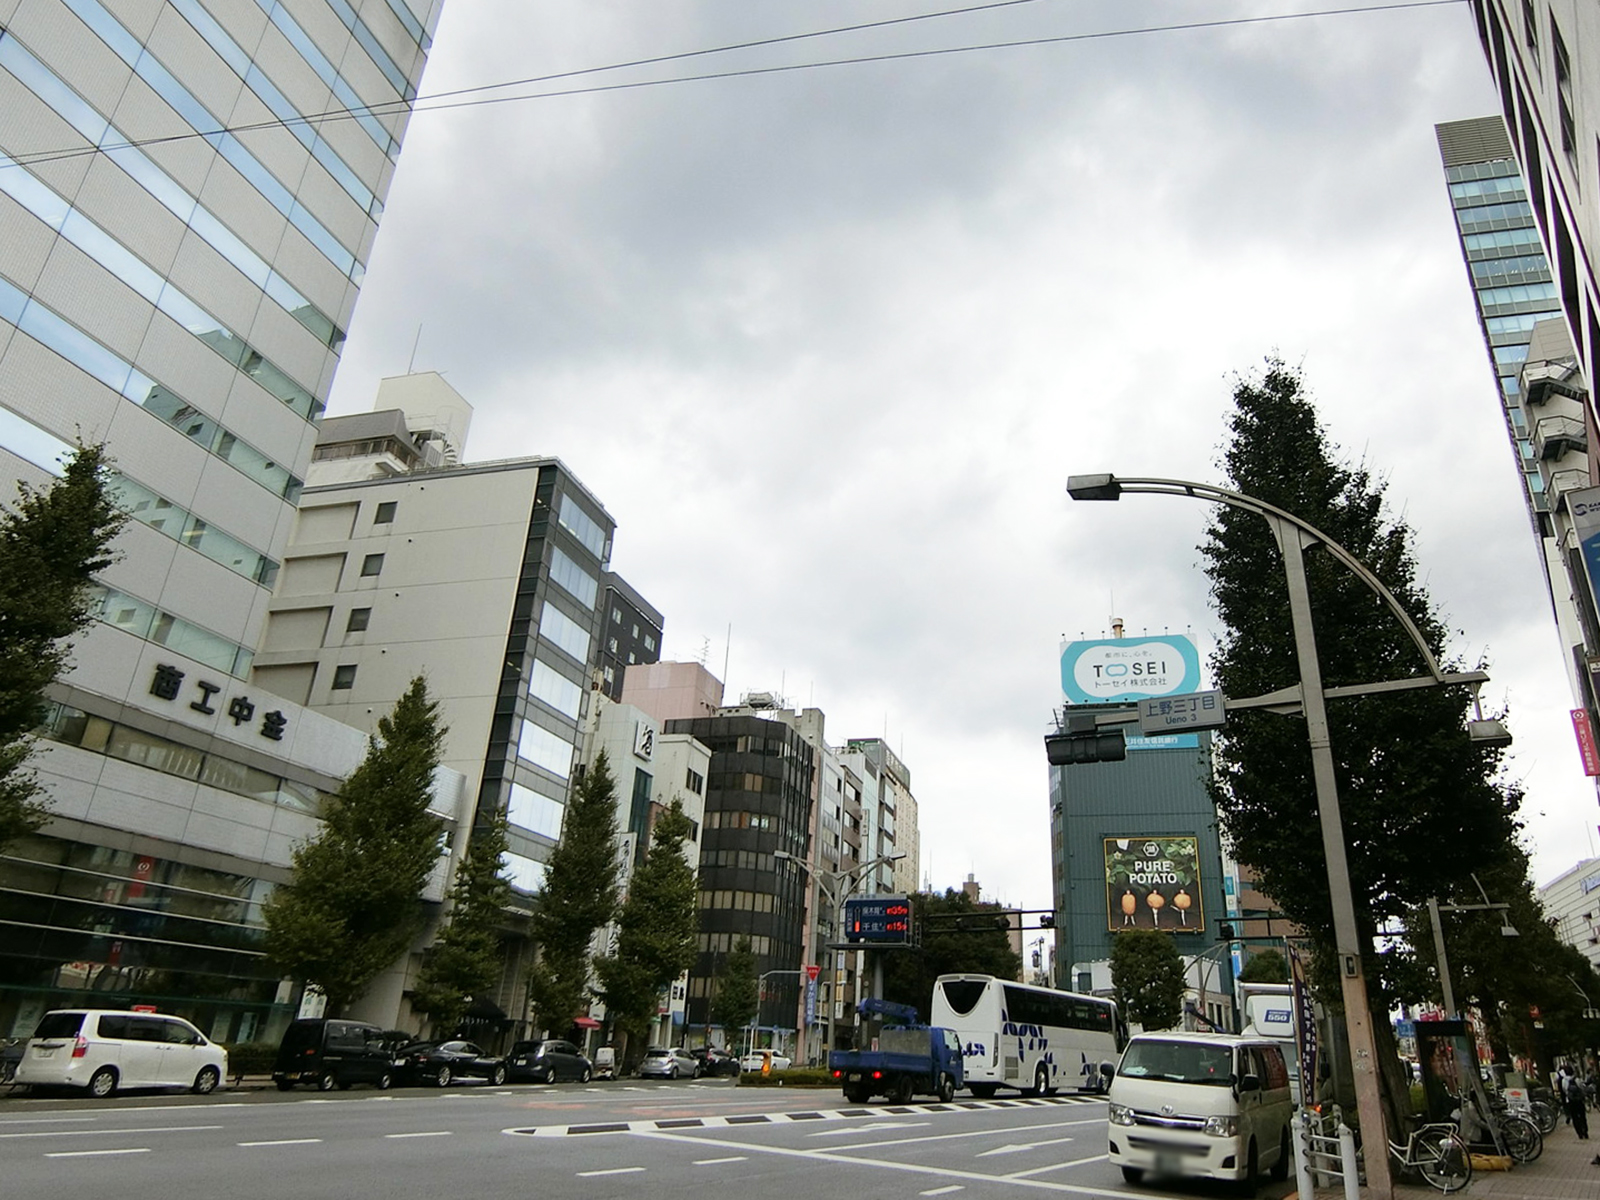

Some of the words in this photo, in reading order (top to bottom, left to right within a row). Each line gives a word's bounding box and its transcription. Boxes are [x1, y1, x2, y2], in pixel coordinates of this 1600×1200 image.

[1093, 661, 1166, 678] TOSEI
[1095, 677, 1167, 688] トーセイ株式会社
[149, 663, 287, 741] 商工中金
[1146, 695, 1215, 717] 上野三丁目
[1165, 715, 1187, 725] Ueno
[1190, 714, 1197, 722] 3
[1134, 861, 1171, 872] PURE
[1129, 873, 1177, 884] POTATO
